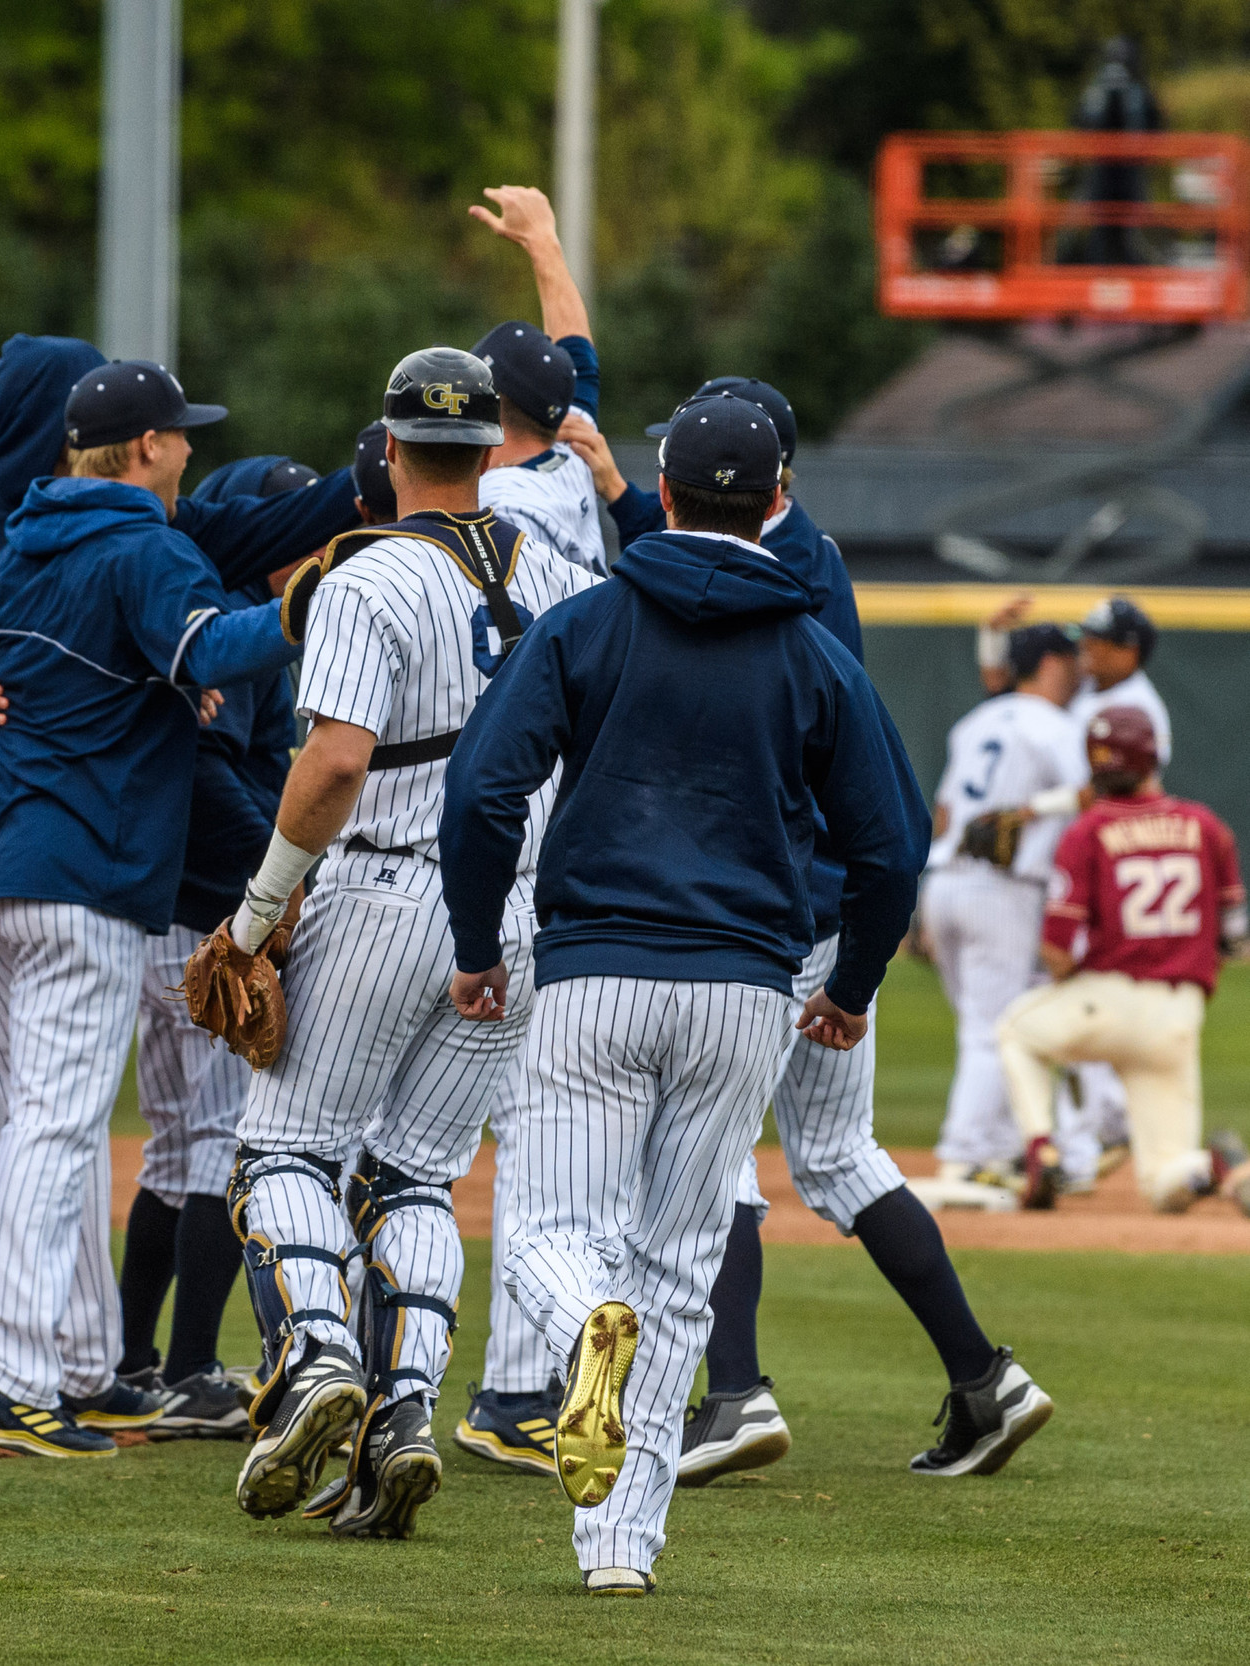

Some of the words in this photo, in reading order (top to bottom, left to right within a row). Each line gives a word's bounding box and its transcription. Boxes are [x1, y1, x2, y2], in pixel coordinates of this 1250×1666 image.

[423, 383, 469, 415] GT
[468, 524, 488, 560] SERIES
[483, 561, 497, 583] PRO
[1115, 853, 1202, 939] 22
